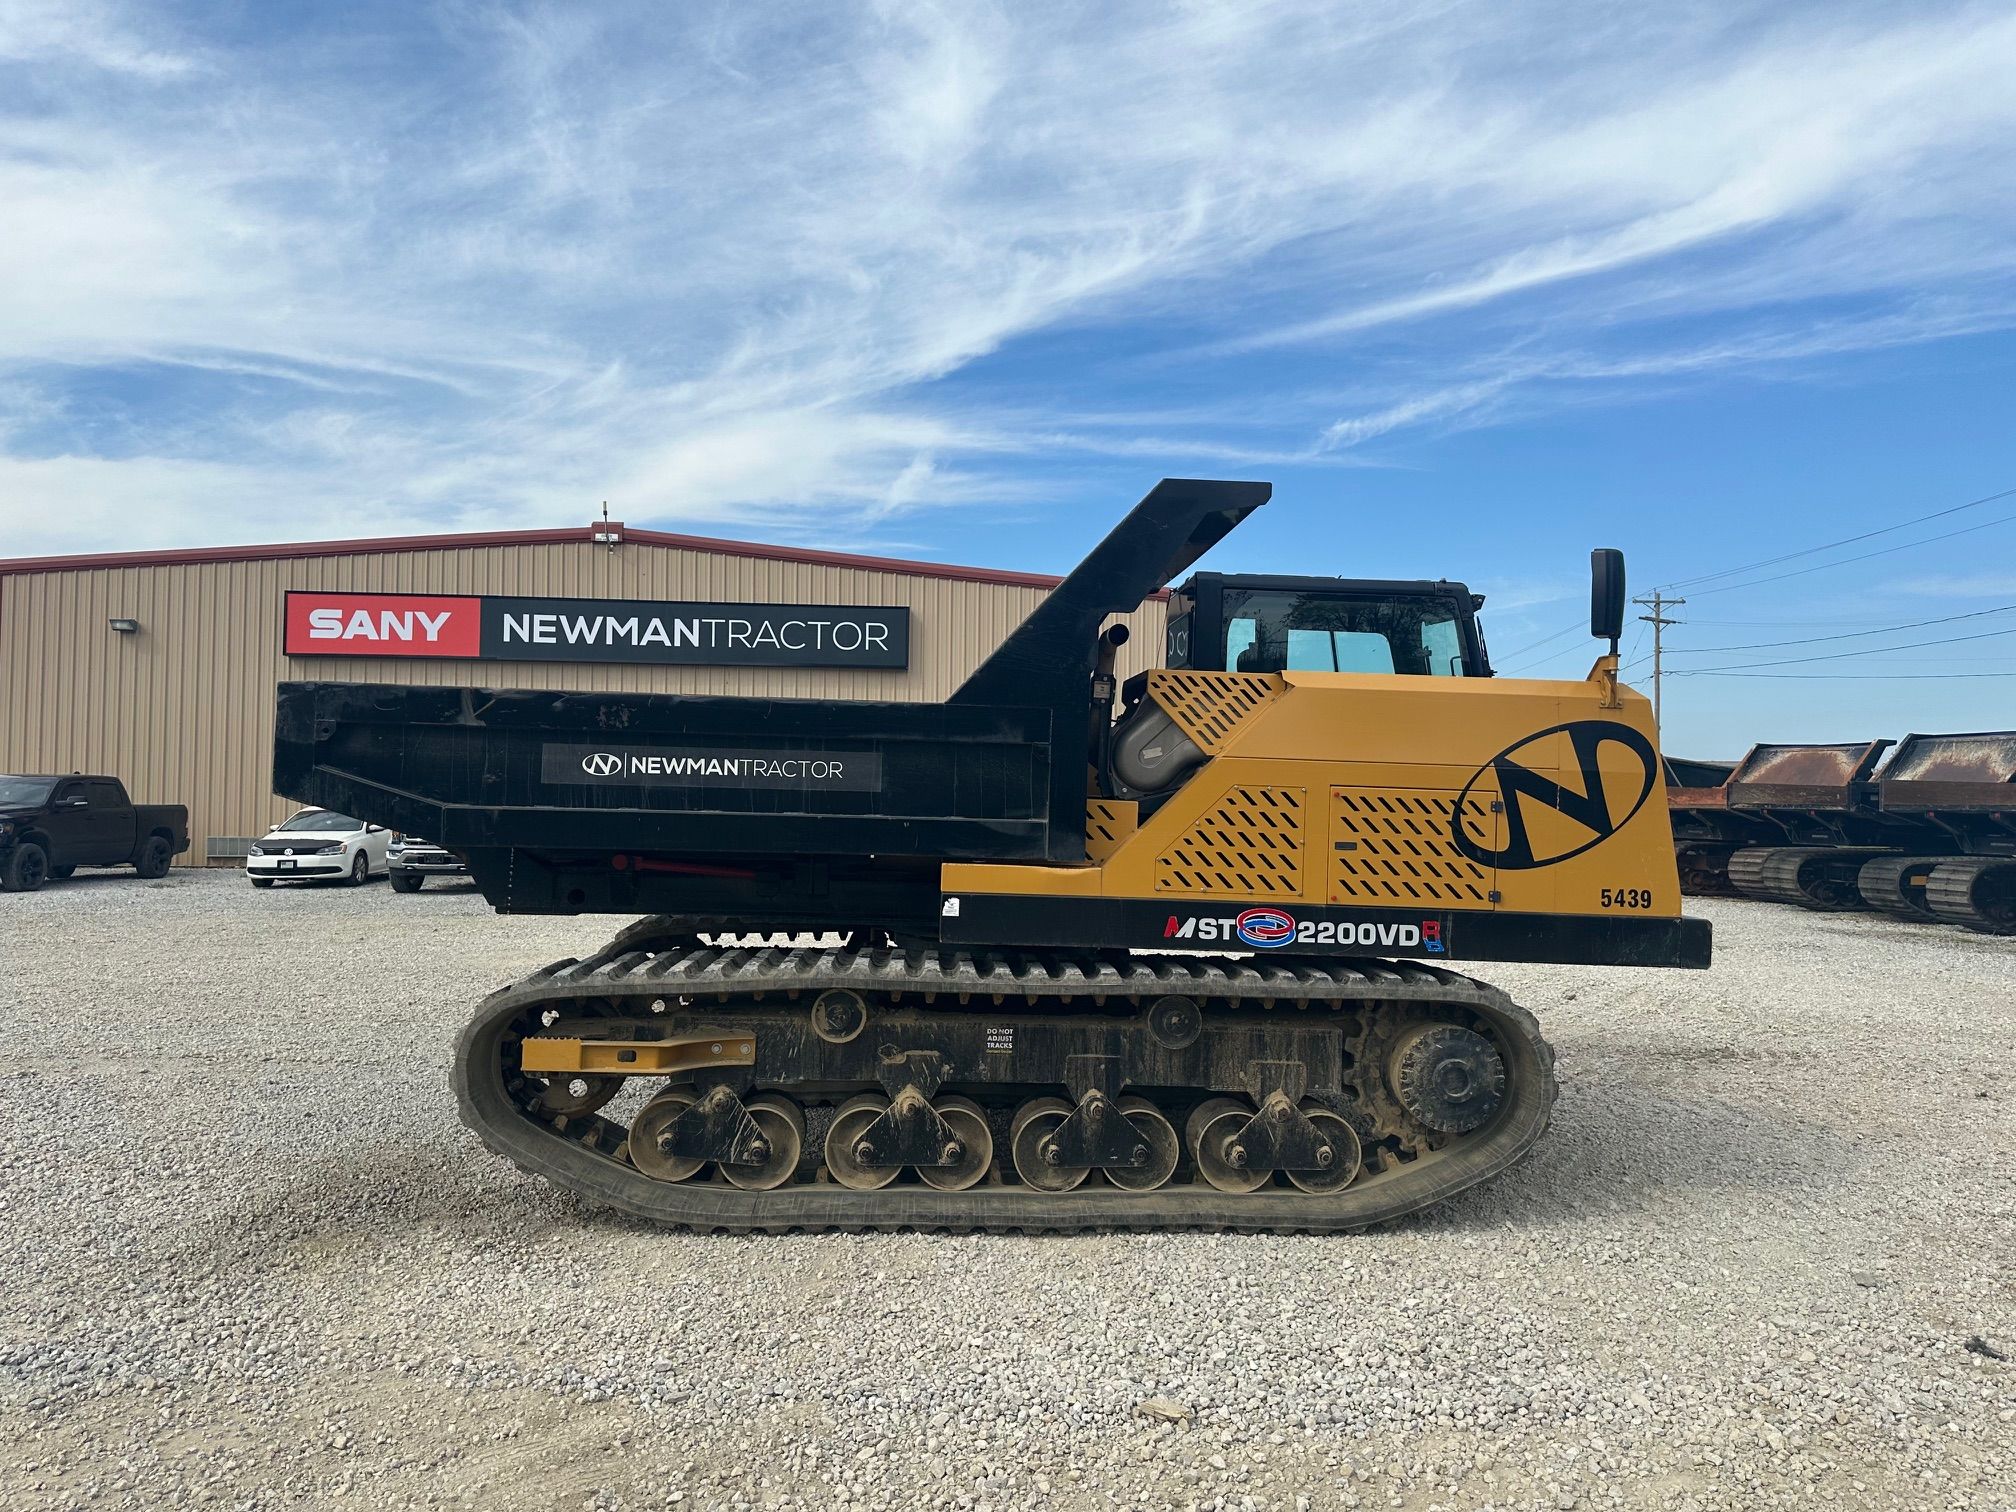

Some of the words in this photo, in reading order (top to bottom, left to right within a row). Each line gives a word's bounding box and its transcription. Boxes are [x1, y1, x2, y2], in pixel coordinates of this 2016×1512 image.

[308, 608, 452, 642] SANY
[1600, 889, 1652, 909] 5439
[1163, 915, 1236, 941] MST
